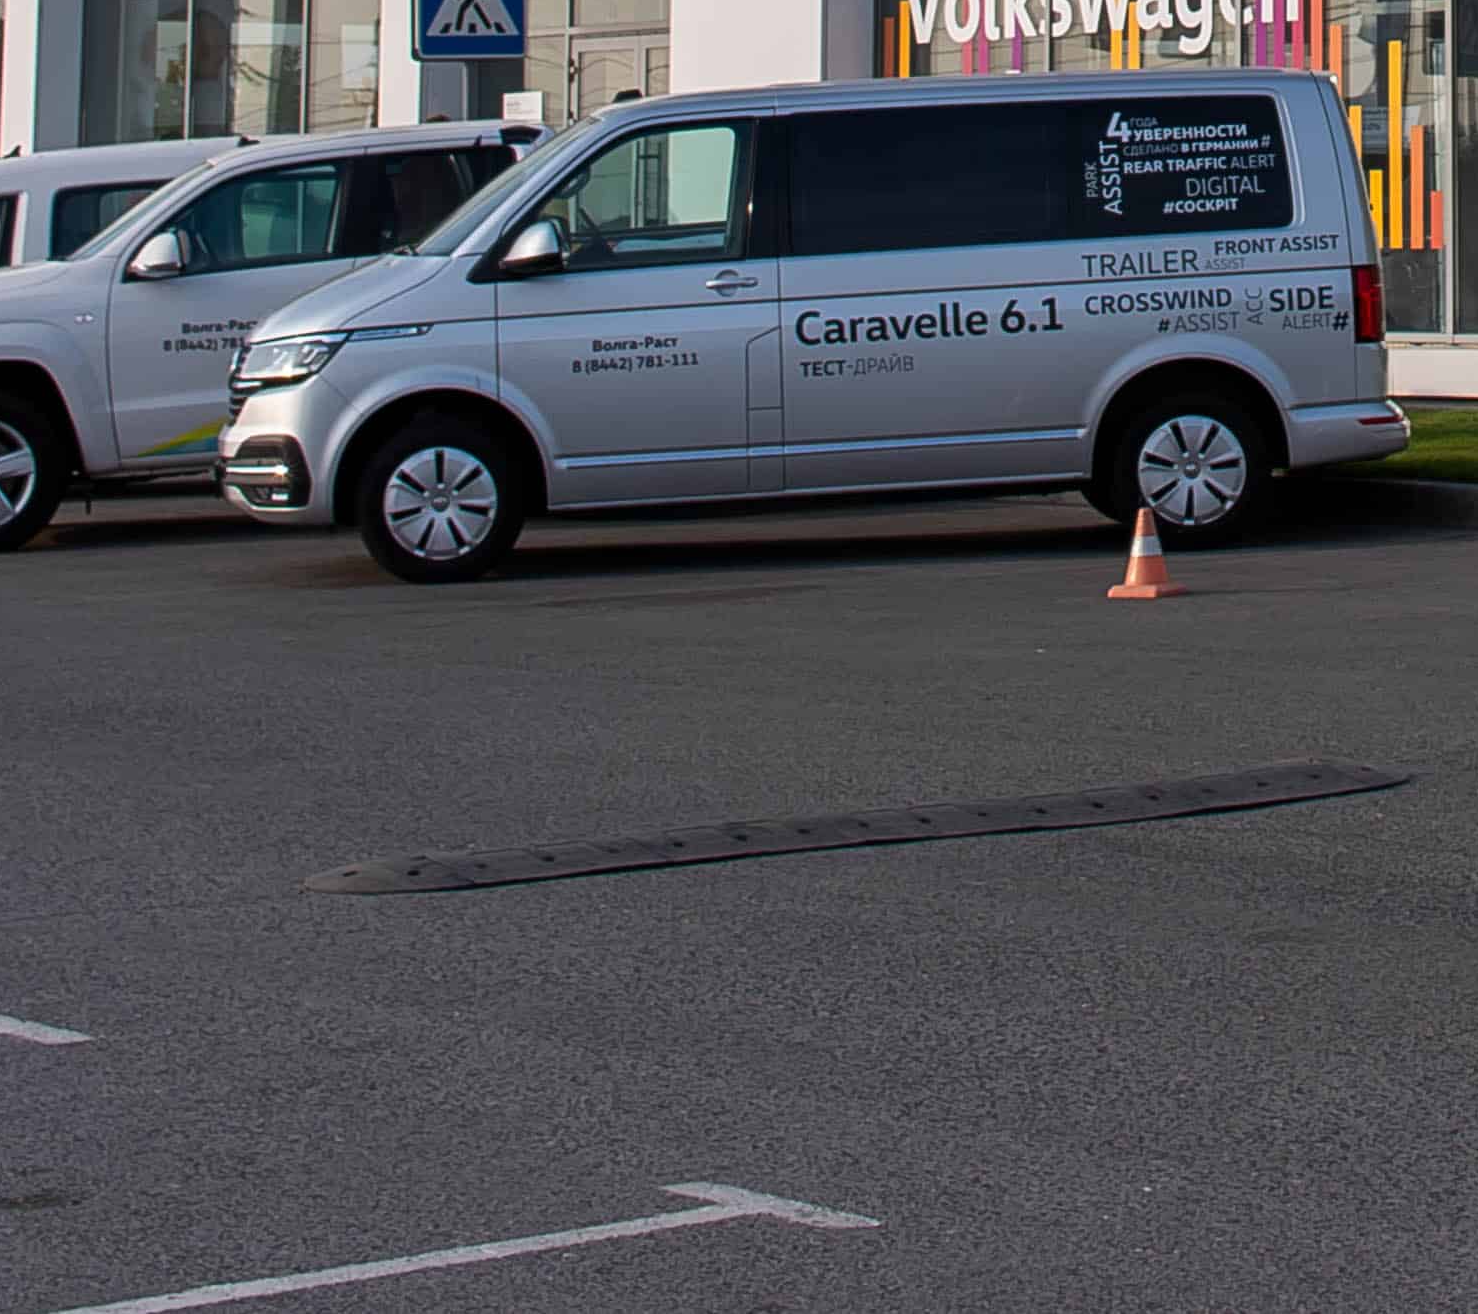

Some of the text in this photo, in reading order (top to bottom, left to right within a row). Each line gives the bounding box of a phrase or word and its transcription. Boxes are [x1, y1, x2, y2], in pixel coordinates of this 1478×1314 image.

[1106, 112, 1132, 143] 4
[1133, 124, 1248, 142] УВЕРЕННОСТИ
[1123, 143, 1179, 157] СДЕЛАНО
[1123, 154, 1276, 174] REAR TRAFFIC ALERT
[1084, 160, 1098, 198] PARK
[1099, 140, 1123, 215] ASSIST
[1185, 175, 1266, 198] DIGITAL
[1214, 234, 1339, 256] FRONT ASSIST
[1081, 248, 1200, 278] TRAILER
[1204, 257, 1246, 271] ASSIST
[1084, 287, 1232, 315] CROSSWIND
[1269, 285, 1335, 313] SIDE
[795, 297, 1064, 346] Caravelle 6.1
[592, 335, 679, 352] Волга-Раст
[572, 352, 699, 375] 8 (8442) 781-111
[800, 353, 915, 378] ТЕСТ-ДРАЙВ
